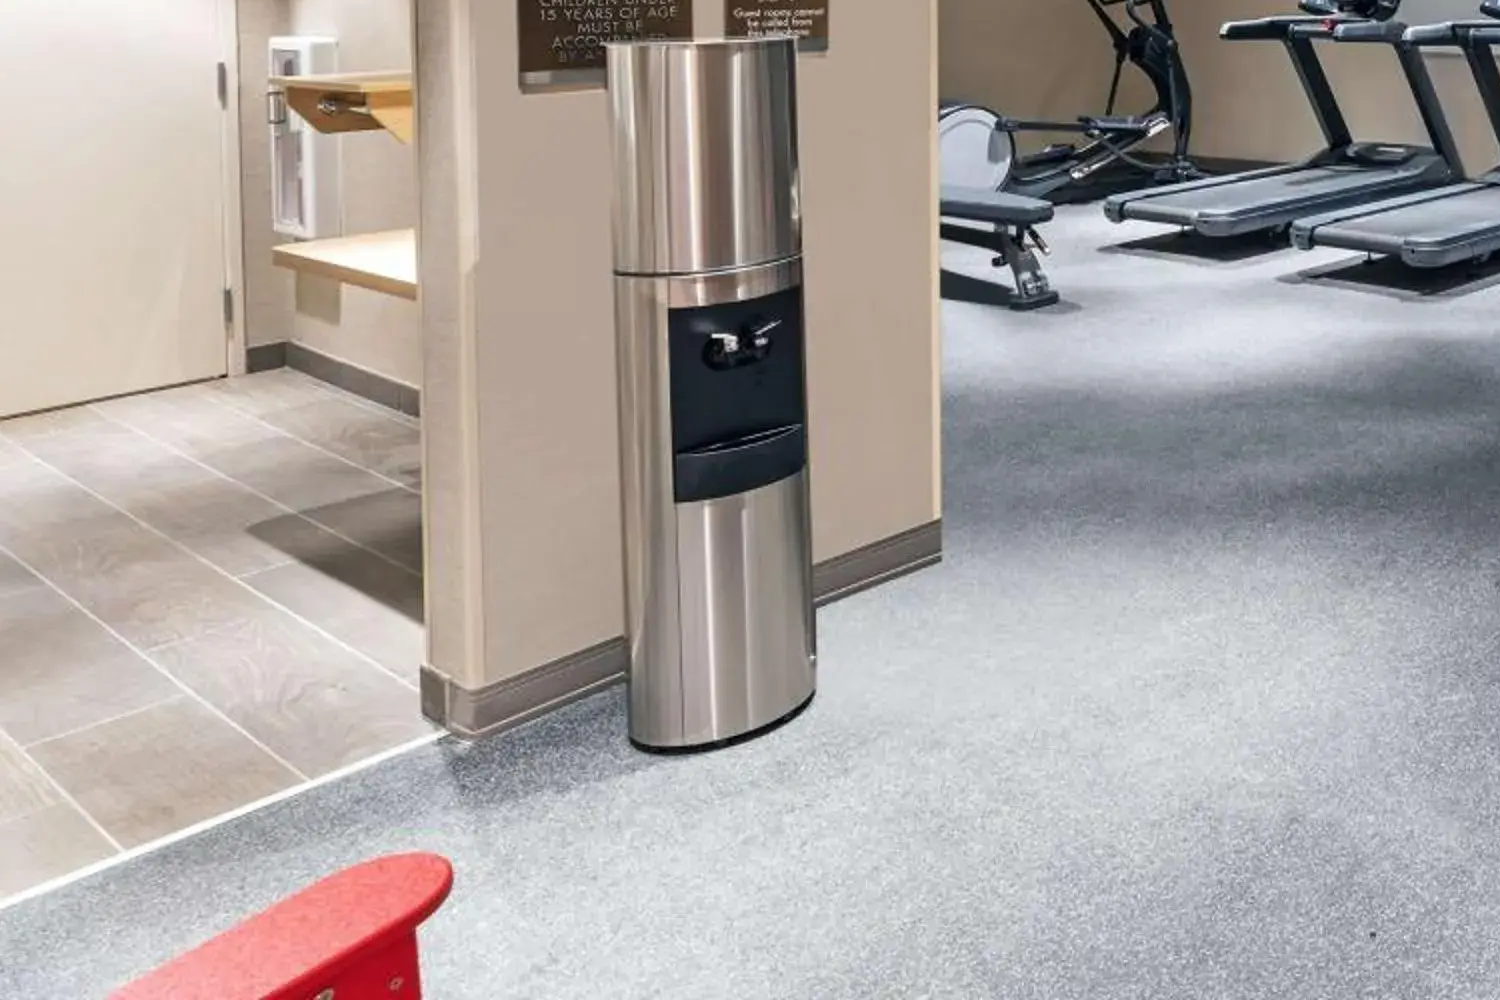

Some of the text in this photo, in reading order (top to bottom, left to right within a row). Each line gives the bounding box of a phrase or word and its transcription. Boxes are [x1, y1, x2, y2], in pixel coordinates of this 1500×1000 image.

[540, 5, 679, 21] 15 YEARS OF AGE
[576, 19, 644, 33] MUST BE
